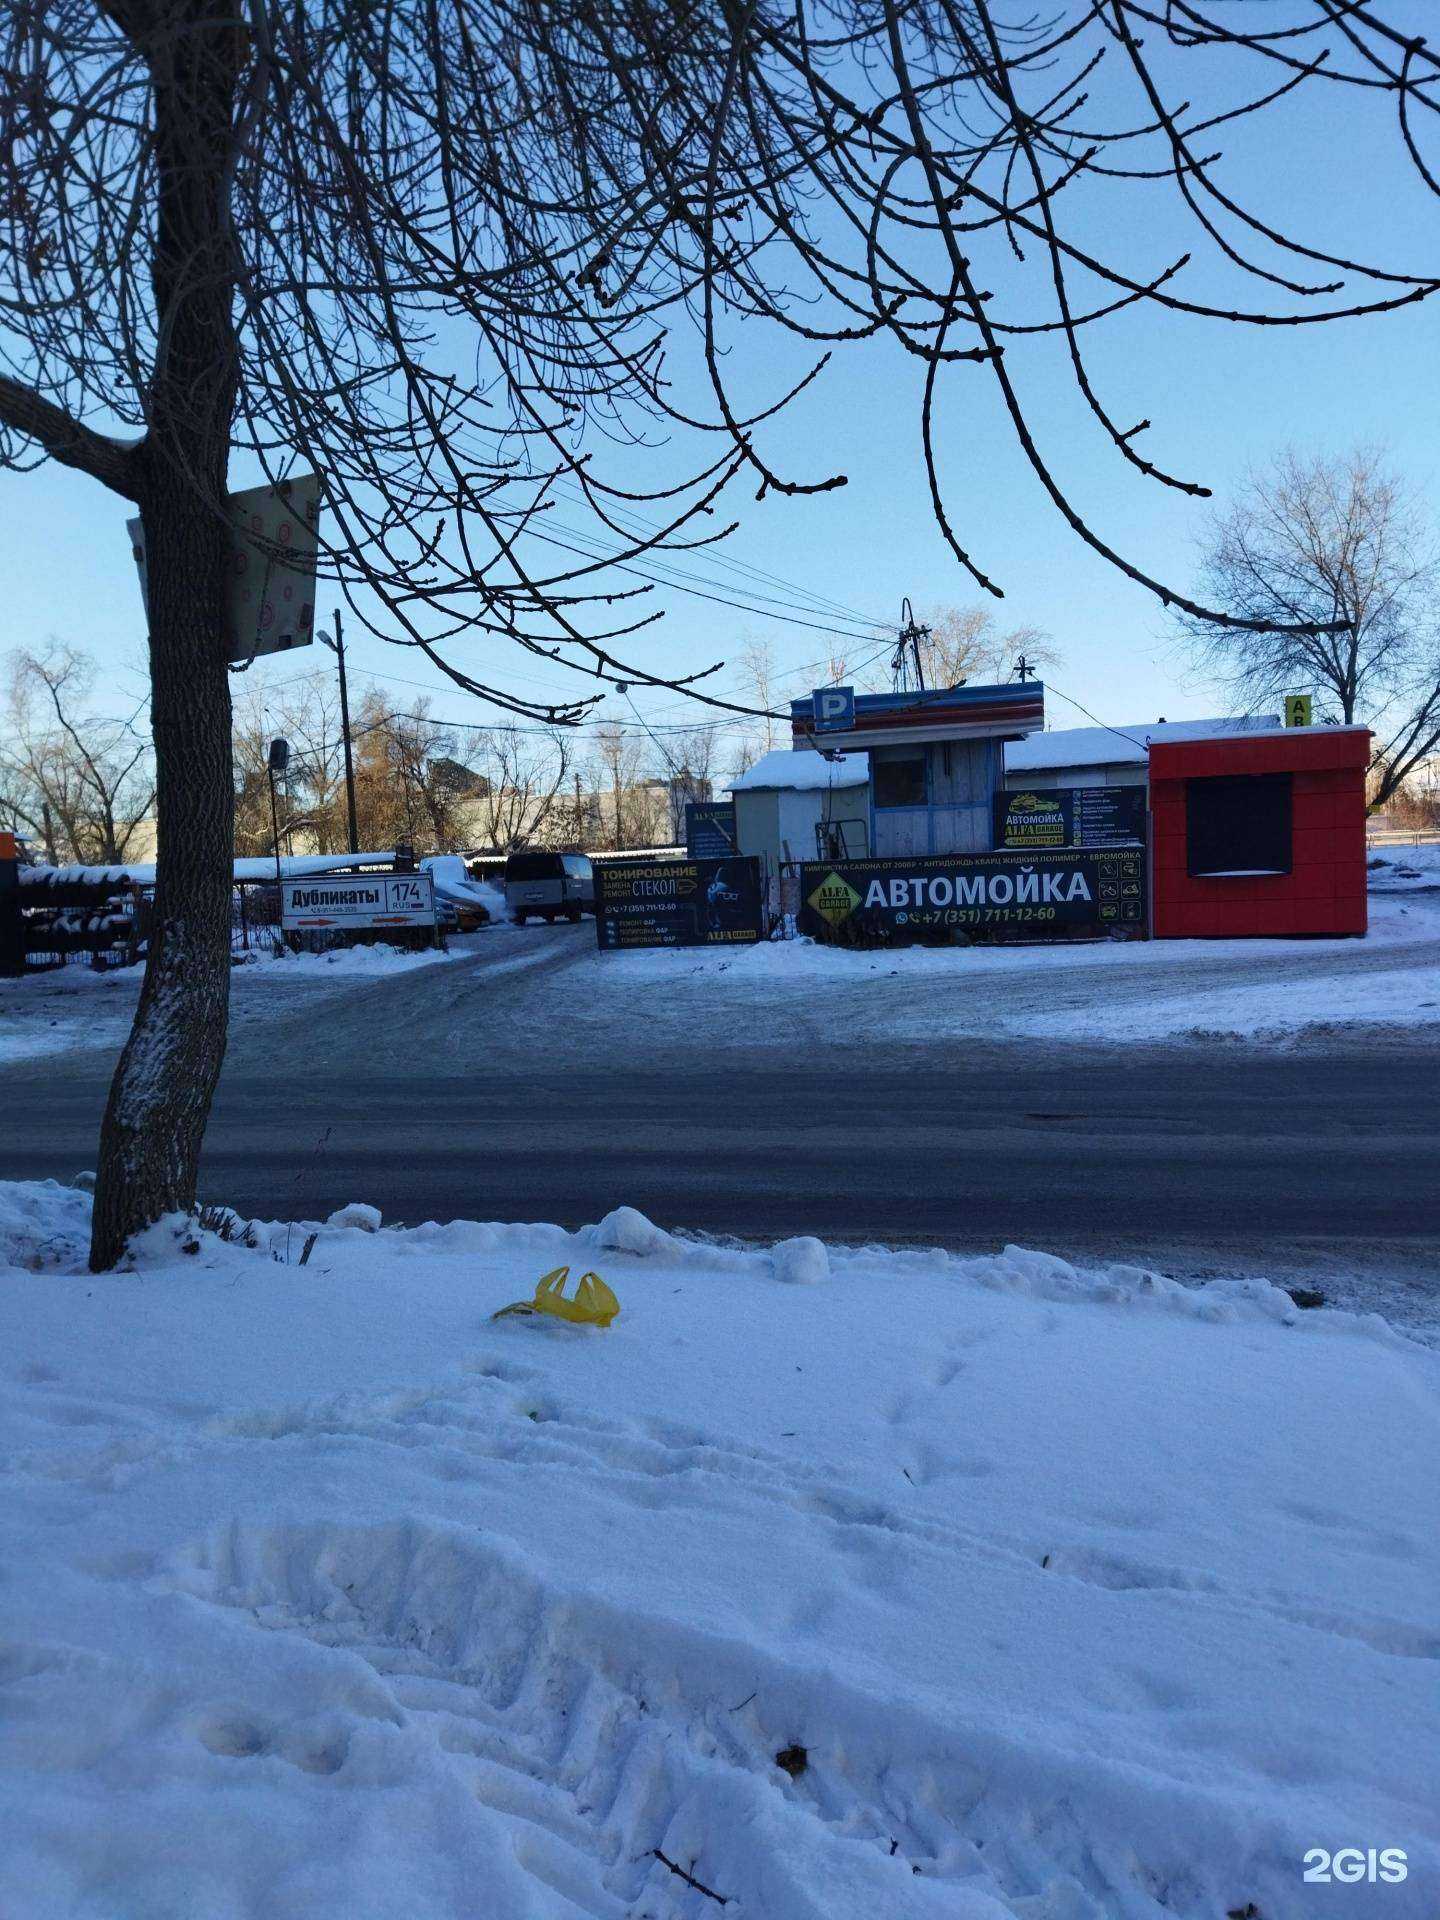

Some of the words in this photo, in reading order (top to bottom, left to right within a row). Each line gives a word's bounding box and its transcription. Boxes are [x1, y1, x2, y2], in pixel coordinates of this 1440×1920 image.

[822, 694, 847, 719] P
[1006, 812, 1064, 825] АВТОМОЙКА
[849, 863, 881, 871] САЛОНА
[882, 862, 893, 870] ОТ
[924, 859, 974, 868] АНТИДОЖДЬ
[1002, 855, 1039, 865] ЖИДКИЙ
[1040, 854, 1081, 863] ПОЛИМЕР
[1090, 851, 1141, 861] ЕВРОМОЙКА
[601, 866, 698, 880] ТОНИРОВАНИЕ
[391, 883, 420, 901] 174
[602, 881, 631, 890] ЗАМЕНА
[632, 879, 676, 897] СТЕКОЛ
[820, 887, 850, 897] ALFA
[865, 866, 1092, 908] АВТОМОЙКА
[292, 888, 379, 908] Дубликаты
[820, 899, 850, 908] GARAGE
[922, 911, 941, 923] +7
[944, 909, 981, 925] (351)
[984, 908, 1056, 922] 711-12-60
[707, 931, 732, 941] ALFA
